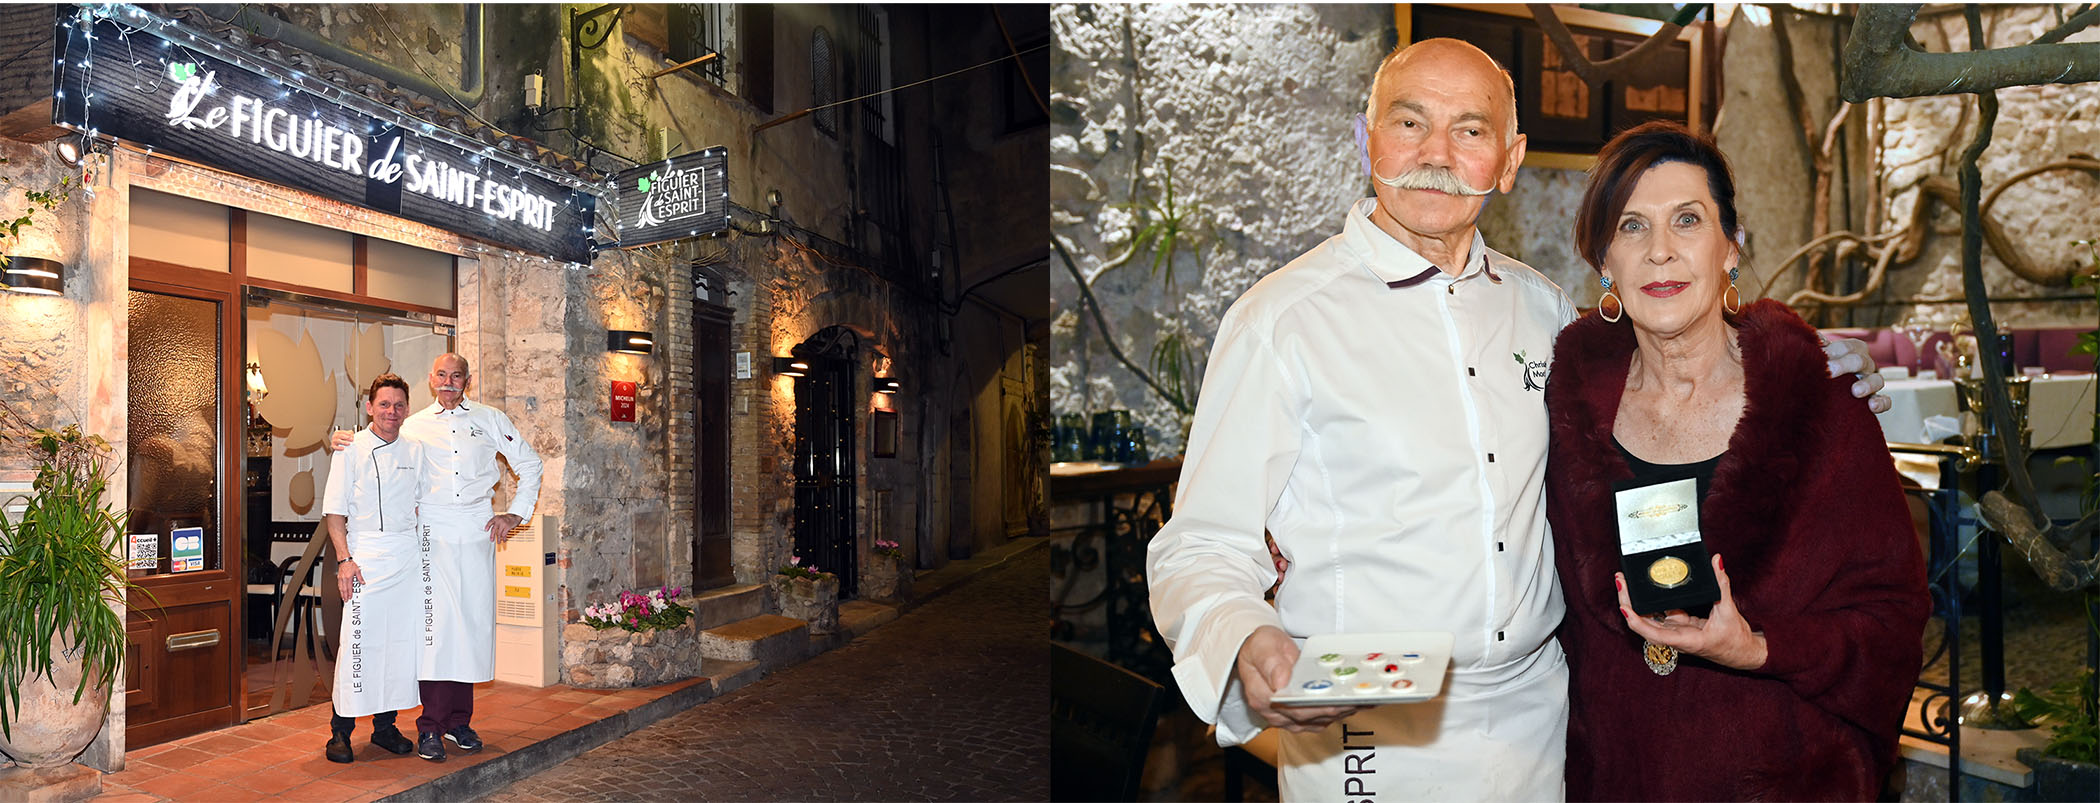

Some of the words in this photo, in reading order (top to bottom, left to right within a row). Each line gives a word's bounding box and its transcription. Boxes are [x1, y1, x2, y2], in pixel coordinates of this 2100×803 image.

[169, 70, 229, 129] Le
[231, 94, 364, 175] FIGUIER
[368, 136, 403, 184] de
[651, 171, 699, 194] FIGUIER
[664, 185, 702, 204] SAINT-
[658, 198, 700, 218] ESPRIT
[422, 524, 431, 552] ESPRIT
[422, 558, 431, 583] SAINT
[424, 585, 432, 596] de
[352, 600, 361, 626] SAINT
[424, 598, 433, 633] FIGUIER
[352, 629, 361, 639] de
[424, 635, 433, 646] LE
[352, 642, 361, 678] FIGUIER
[353, 681, 362, 693] LE
[1343, 723, 1377, 803] PRIT
